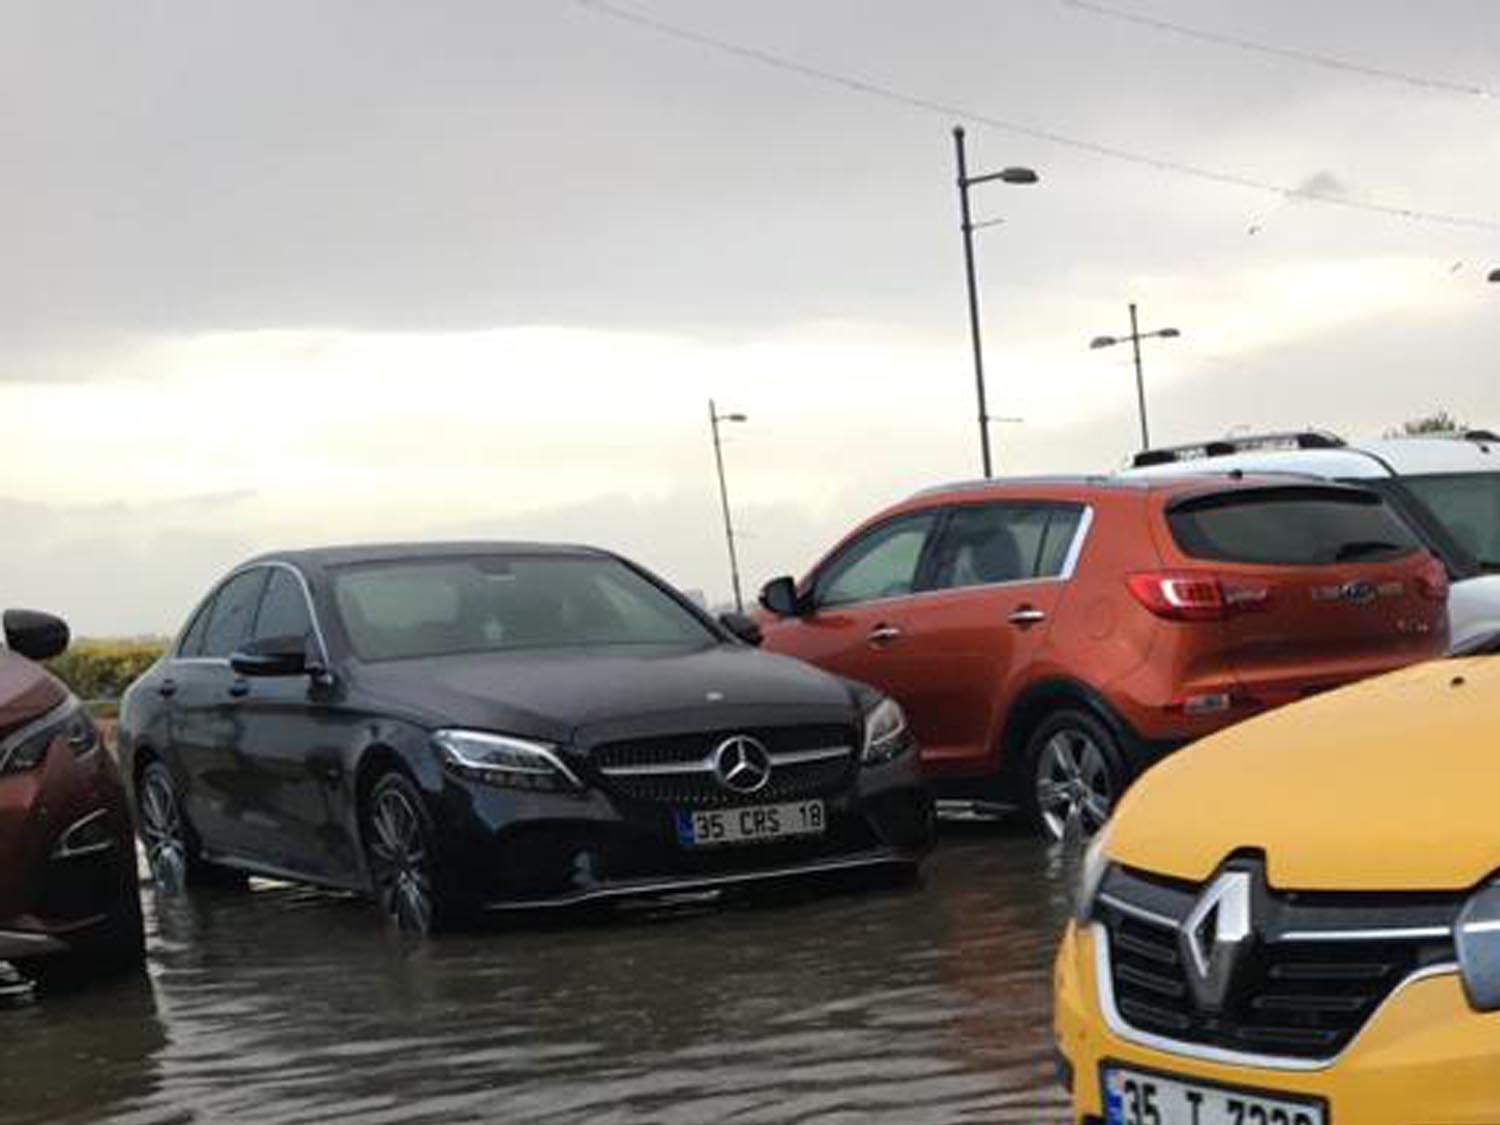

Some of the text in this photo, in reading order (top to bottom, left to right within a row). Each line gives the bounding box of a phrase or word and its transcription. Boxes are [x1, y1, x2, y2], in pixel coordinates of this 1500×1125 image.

[696, 802, 821, 839] 35 CRS 18
